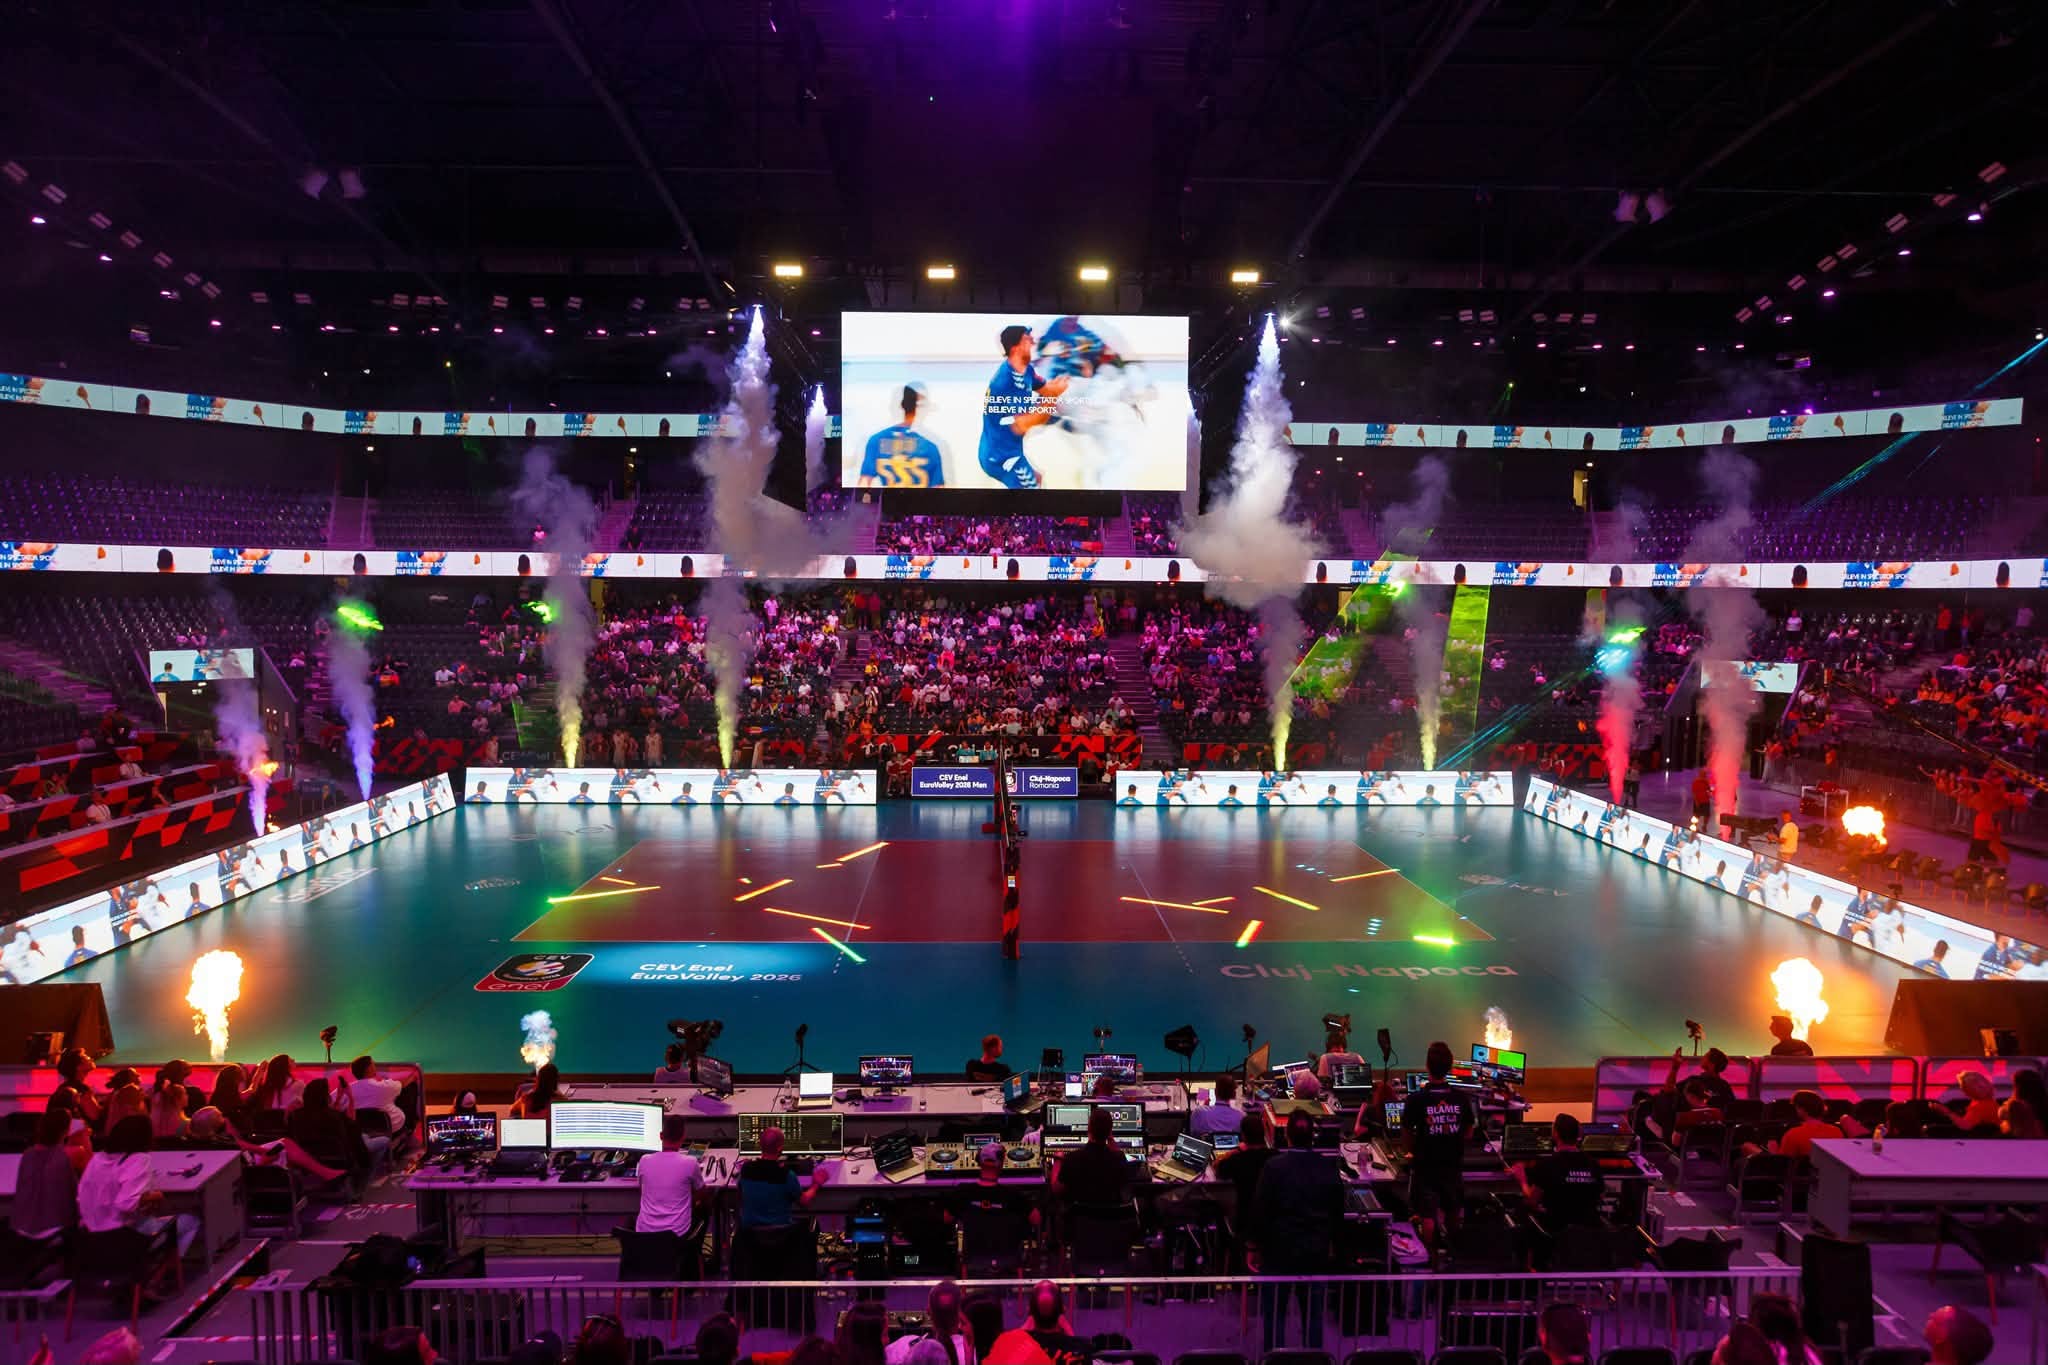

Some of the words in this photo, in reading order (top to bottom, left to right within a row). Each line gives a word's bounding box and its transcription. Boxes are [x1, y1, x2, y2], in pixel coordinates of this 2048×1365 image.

[1013, 396, 1022, 404] IN
[1024, 396, 1063, 404] SPECTATOR
[988, 406, 1016, 414] BELIEVE
[1018, 406, 1026, 414] IN
[1028, 406, 1058, 414] SPORTS
[1029, 775, 1071, 783] Cluj-Napoca
[920, 781, 954, 789] EuroVolley
[639, 963, 685, 972] CEV
[688, 963, 733, 972] Enel
[1219, 963, 1519, 981] Cluj-Napoca
[630, 972, 745, 982] EuroVolley
[750, 973, 803, 981] 2026
[488, 982, 550, 990] enel
[1426, 1105, 1461, 1114] BLAME
